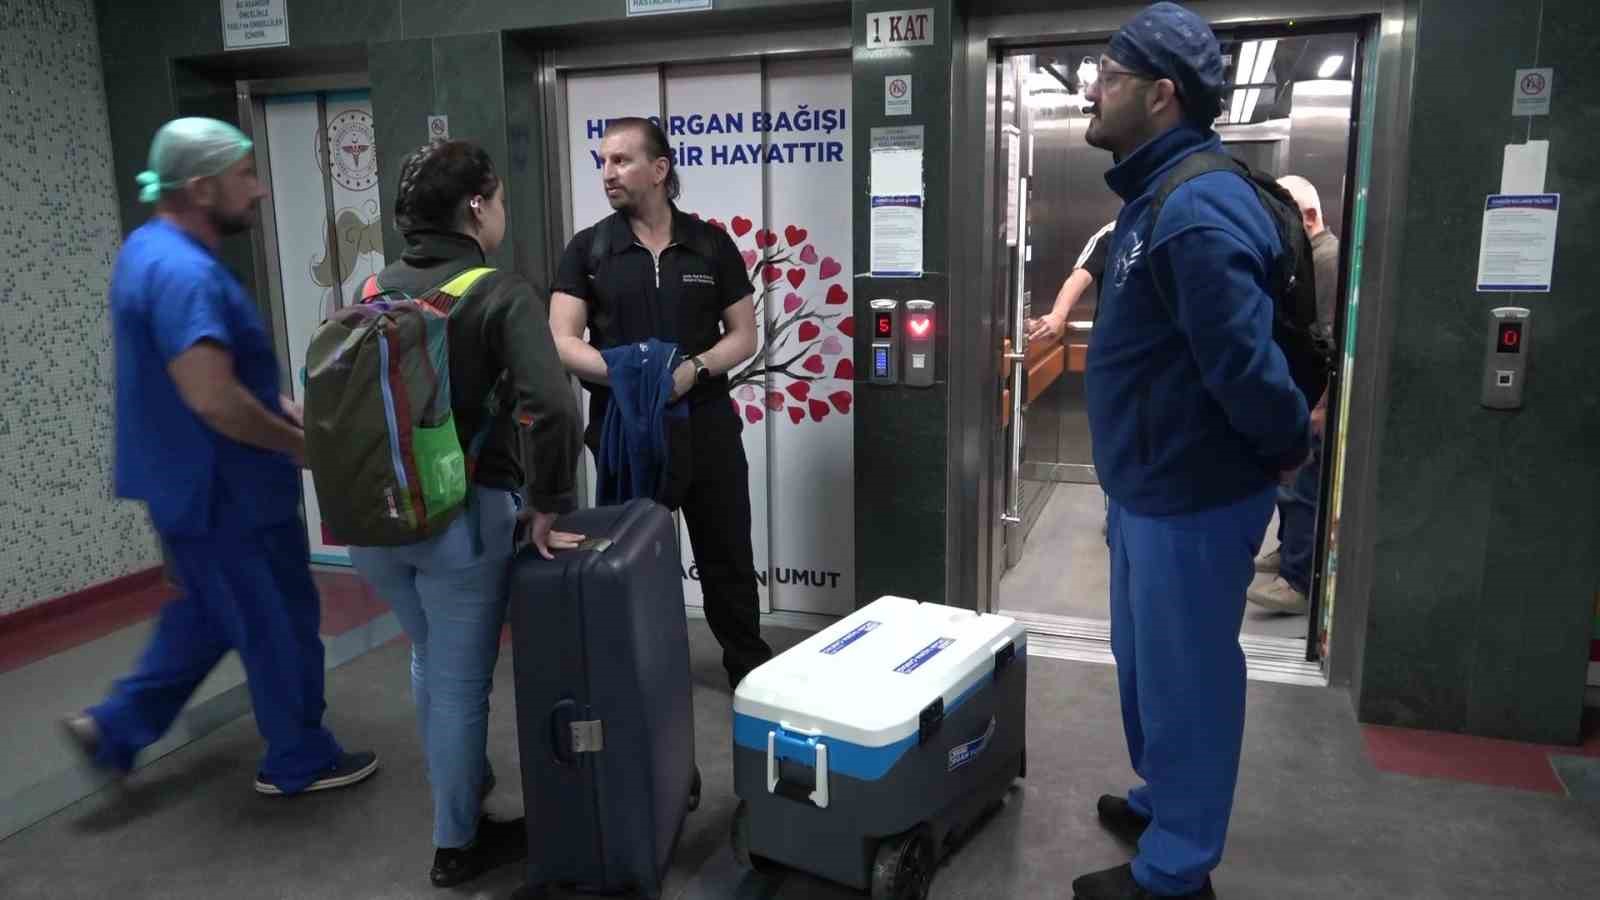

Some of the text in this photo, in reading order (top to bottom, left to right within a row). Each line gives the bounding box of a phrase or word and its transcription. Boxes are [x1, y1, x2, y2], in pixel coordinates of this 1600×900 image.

[873, 14, 928, 42] 1 KAT
[752, 105, 846, 133] BAĞIŞI
[711, 142, 843, 166] HAYATTIR
[879, 319, 889, 332] 5
[1503, 330, 1517, 345] 0
[776, 568, 841, 588] UMUT
